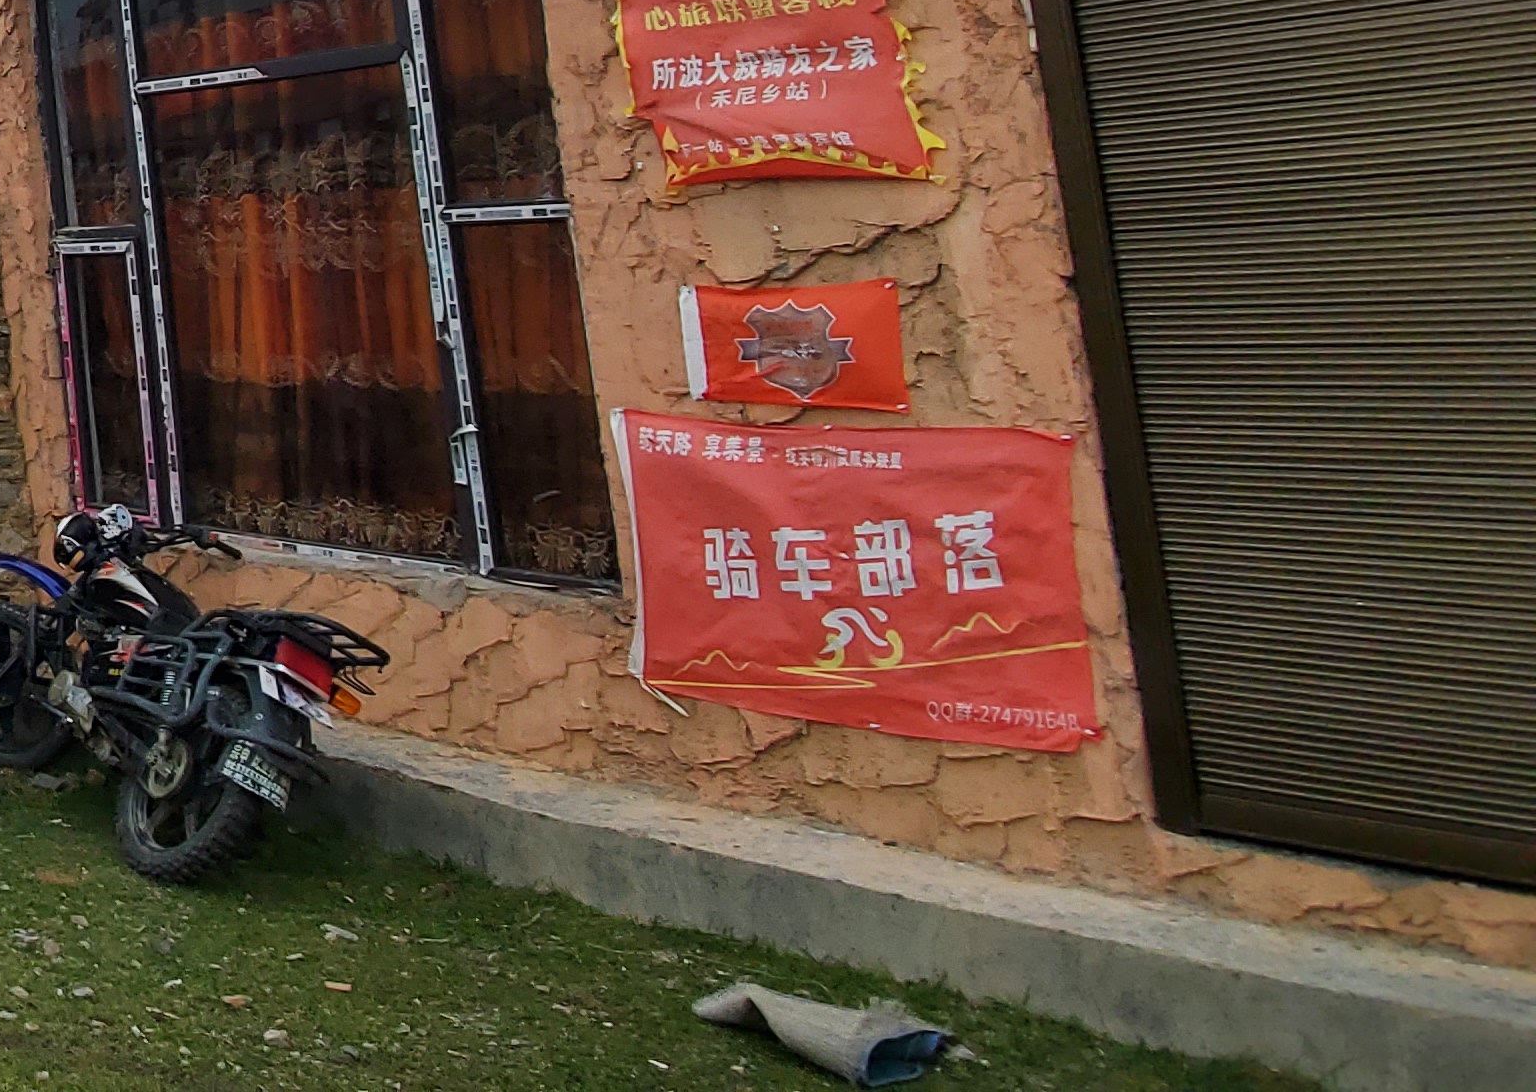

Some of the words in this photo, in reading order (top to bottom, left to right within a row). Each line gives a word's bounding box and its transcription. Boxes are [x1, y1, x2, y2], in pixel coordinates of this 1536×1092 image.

[652, 35, 878, 91] 所波大叔骑友之家
[701, 509, 1006, 604] 骑车部落
